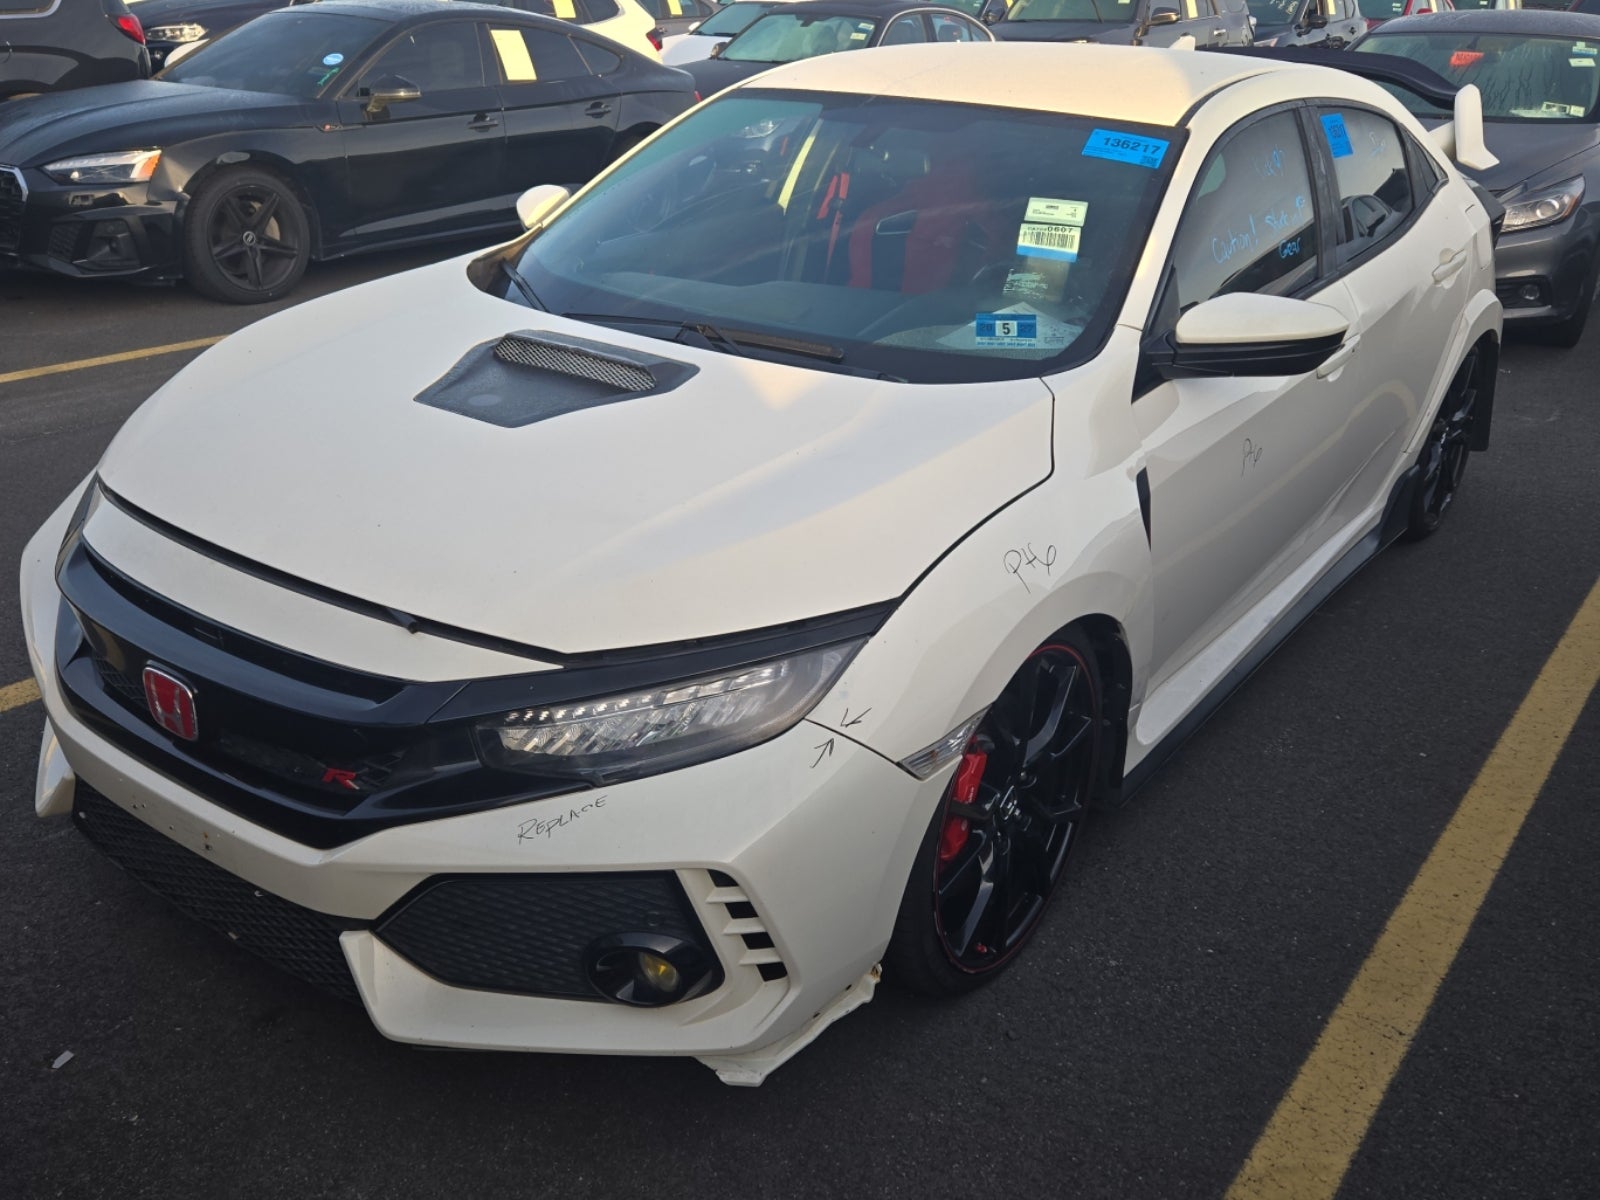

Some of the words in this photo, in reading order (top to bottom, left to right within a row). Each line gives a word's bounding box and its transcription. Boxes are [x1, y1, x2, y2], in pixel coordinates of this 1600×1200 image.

[1104, 136, 1161, 154] 136217
[1001, 322, 1011, 335] 5
[517, 795, 607, 845] REPLACE
